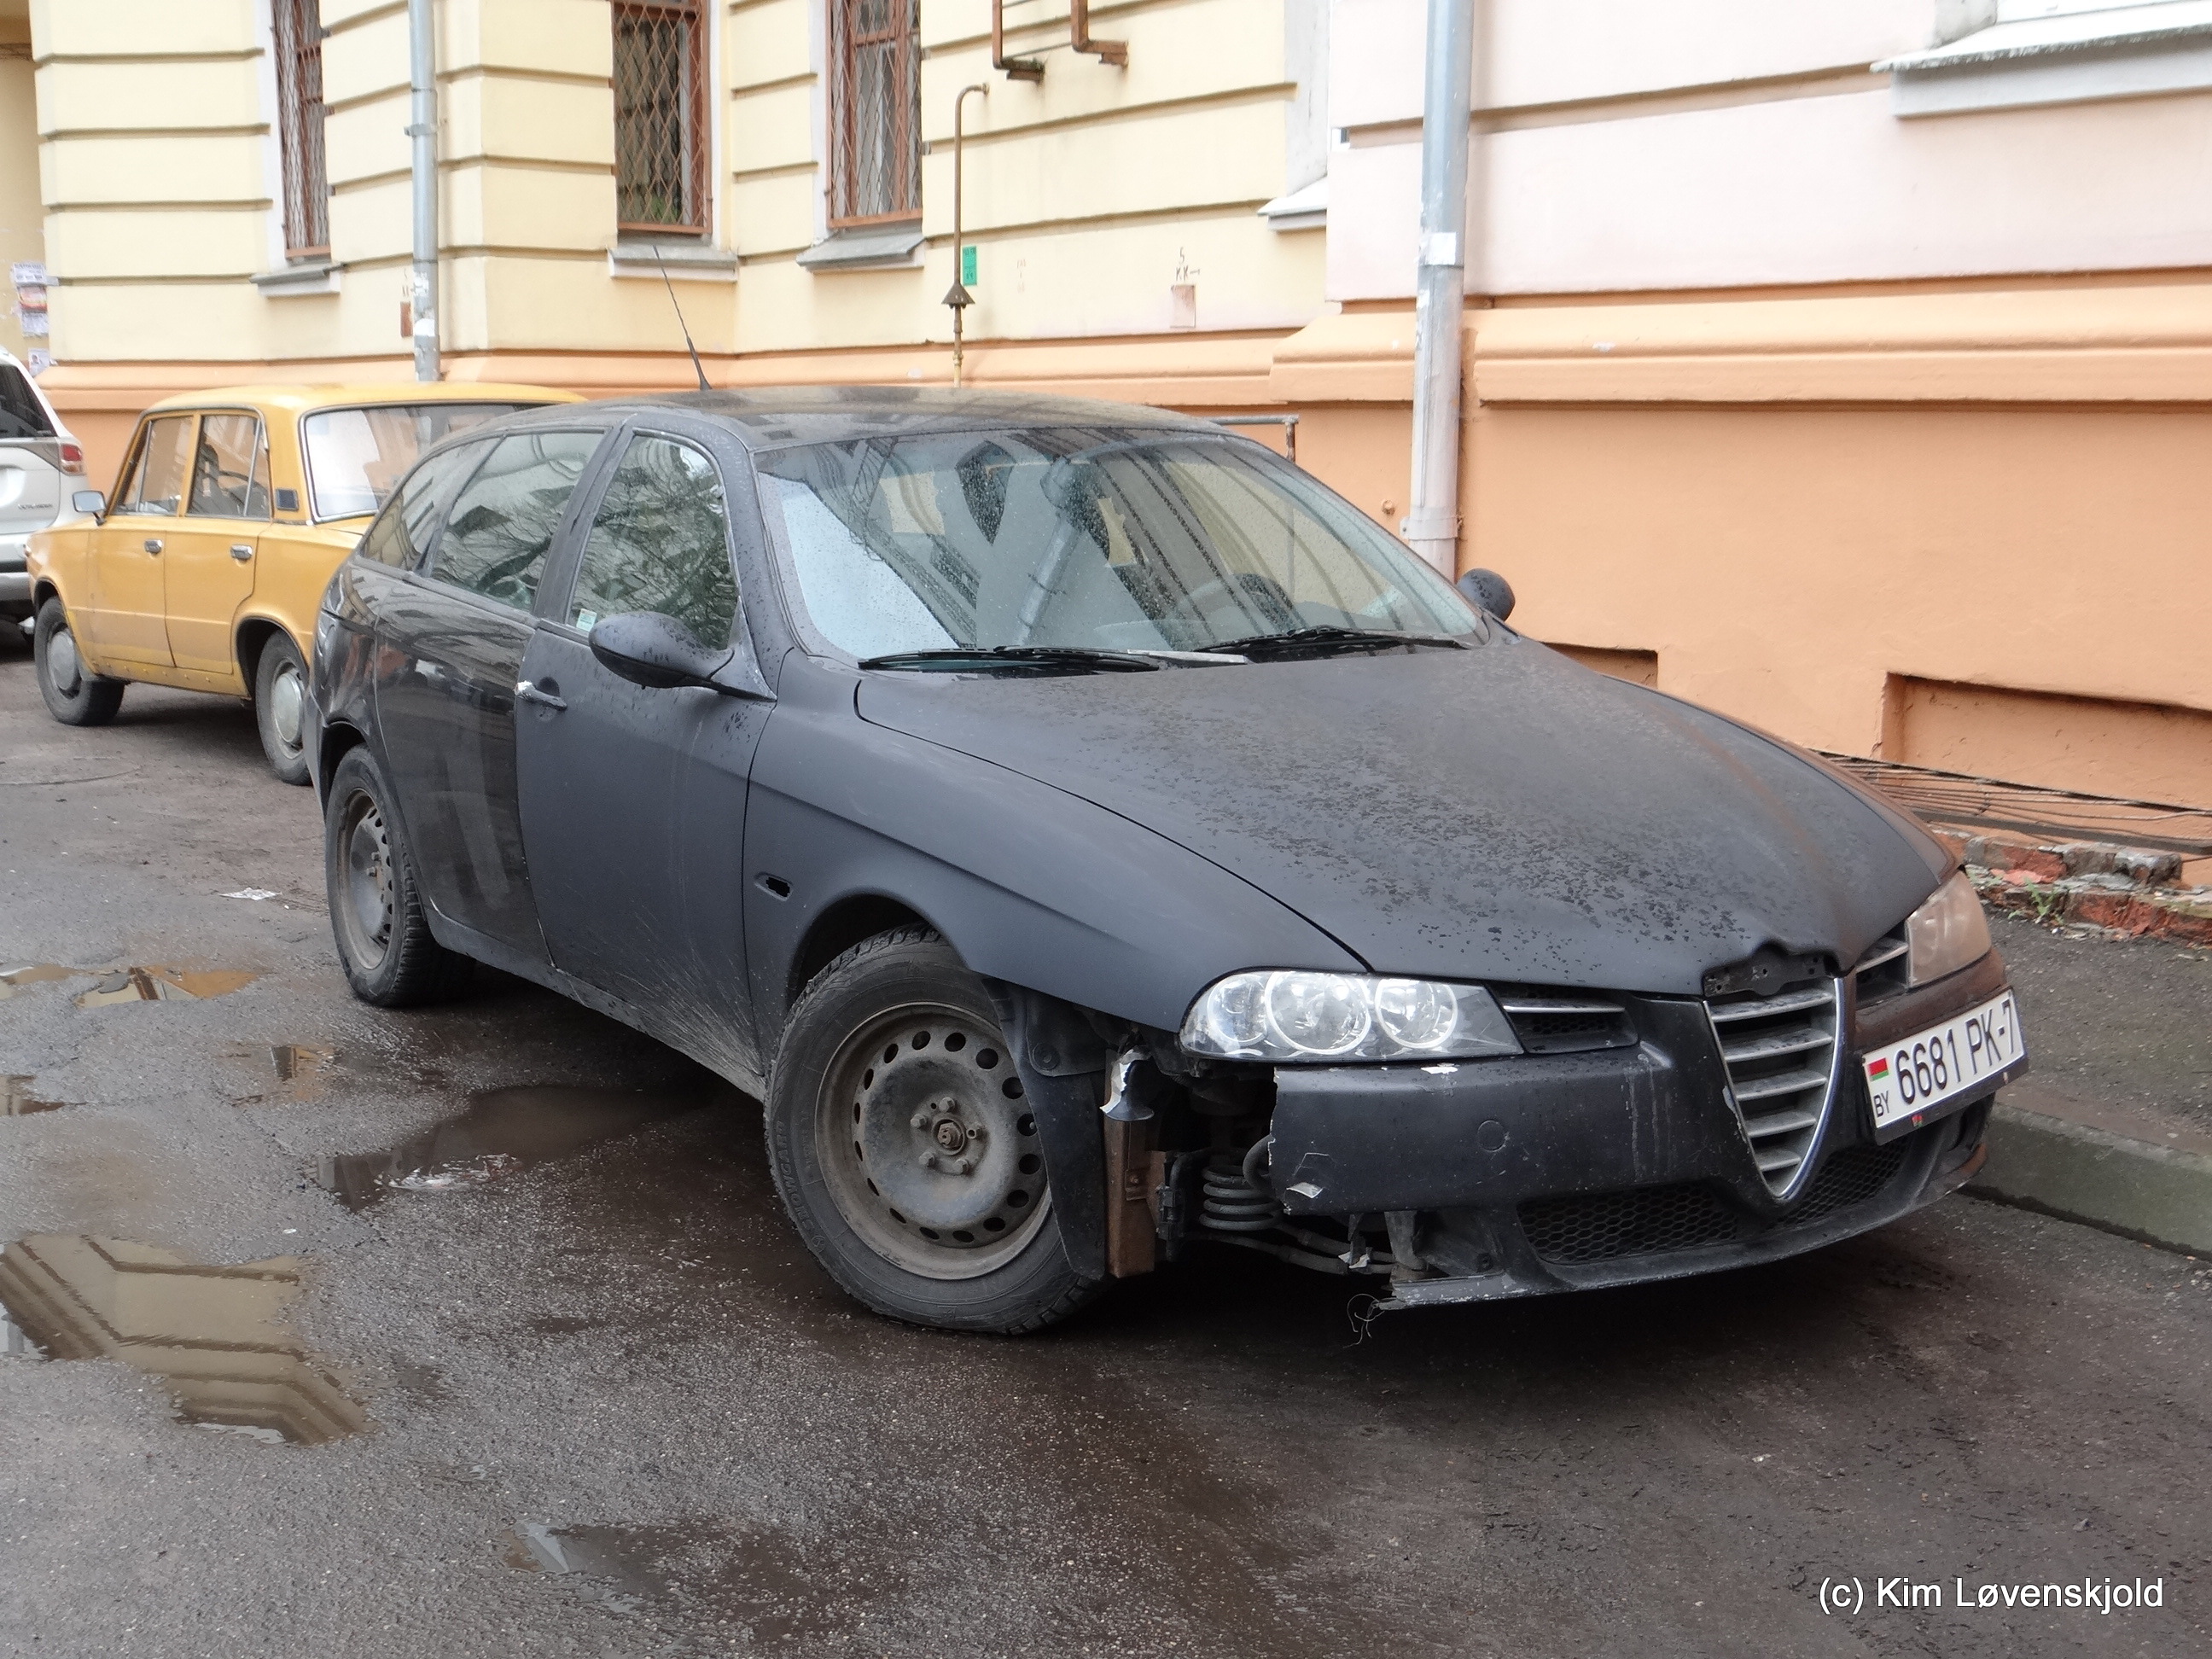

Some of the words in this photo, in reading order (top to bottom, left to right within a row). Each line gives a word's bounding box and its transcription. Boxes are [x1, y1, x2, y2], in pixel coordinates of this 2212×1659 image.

[1894, 1027, 1961, 1105] 6681
[1965, 998, 2015, 1075] PK-7
[1873, 1090, 1890, 1118] BY
